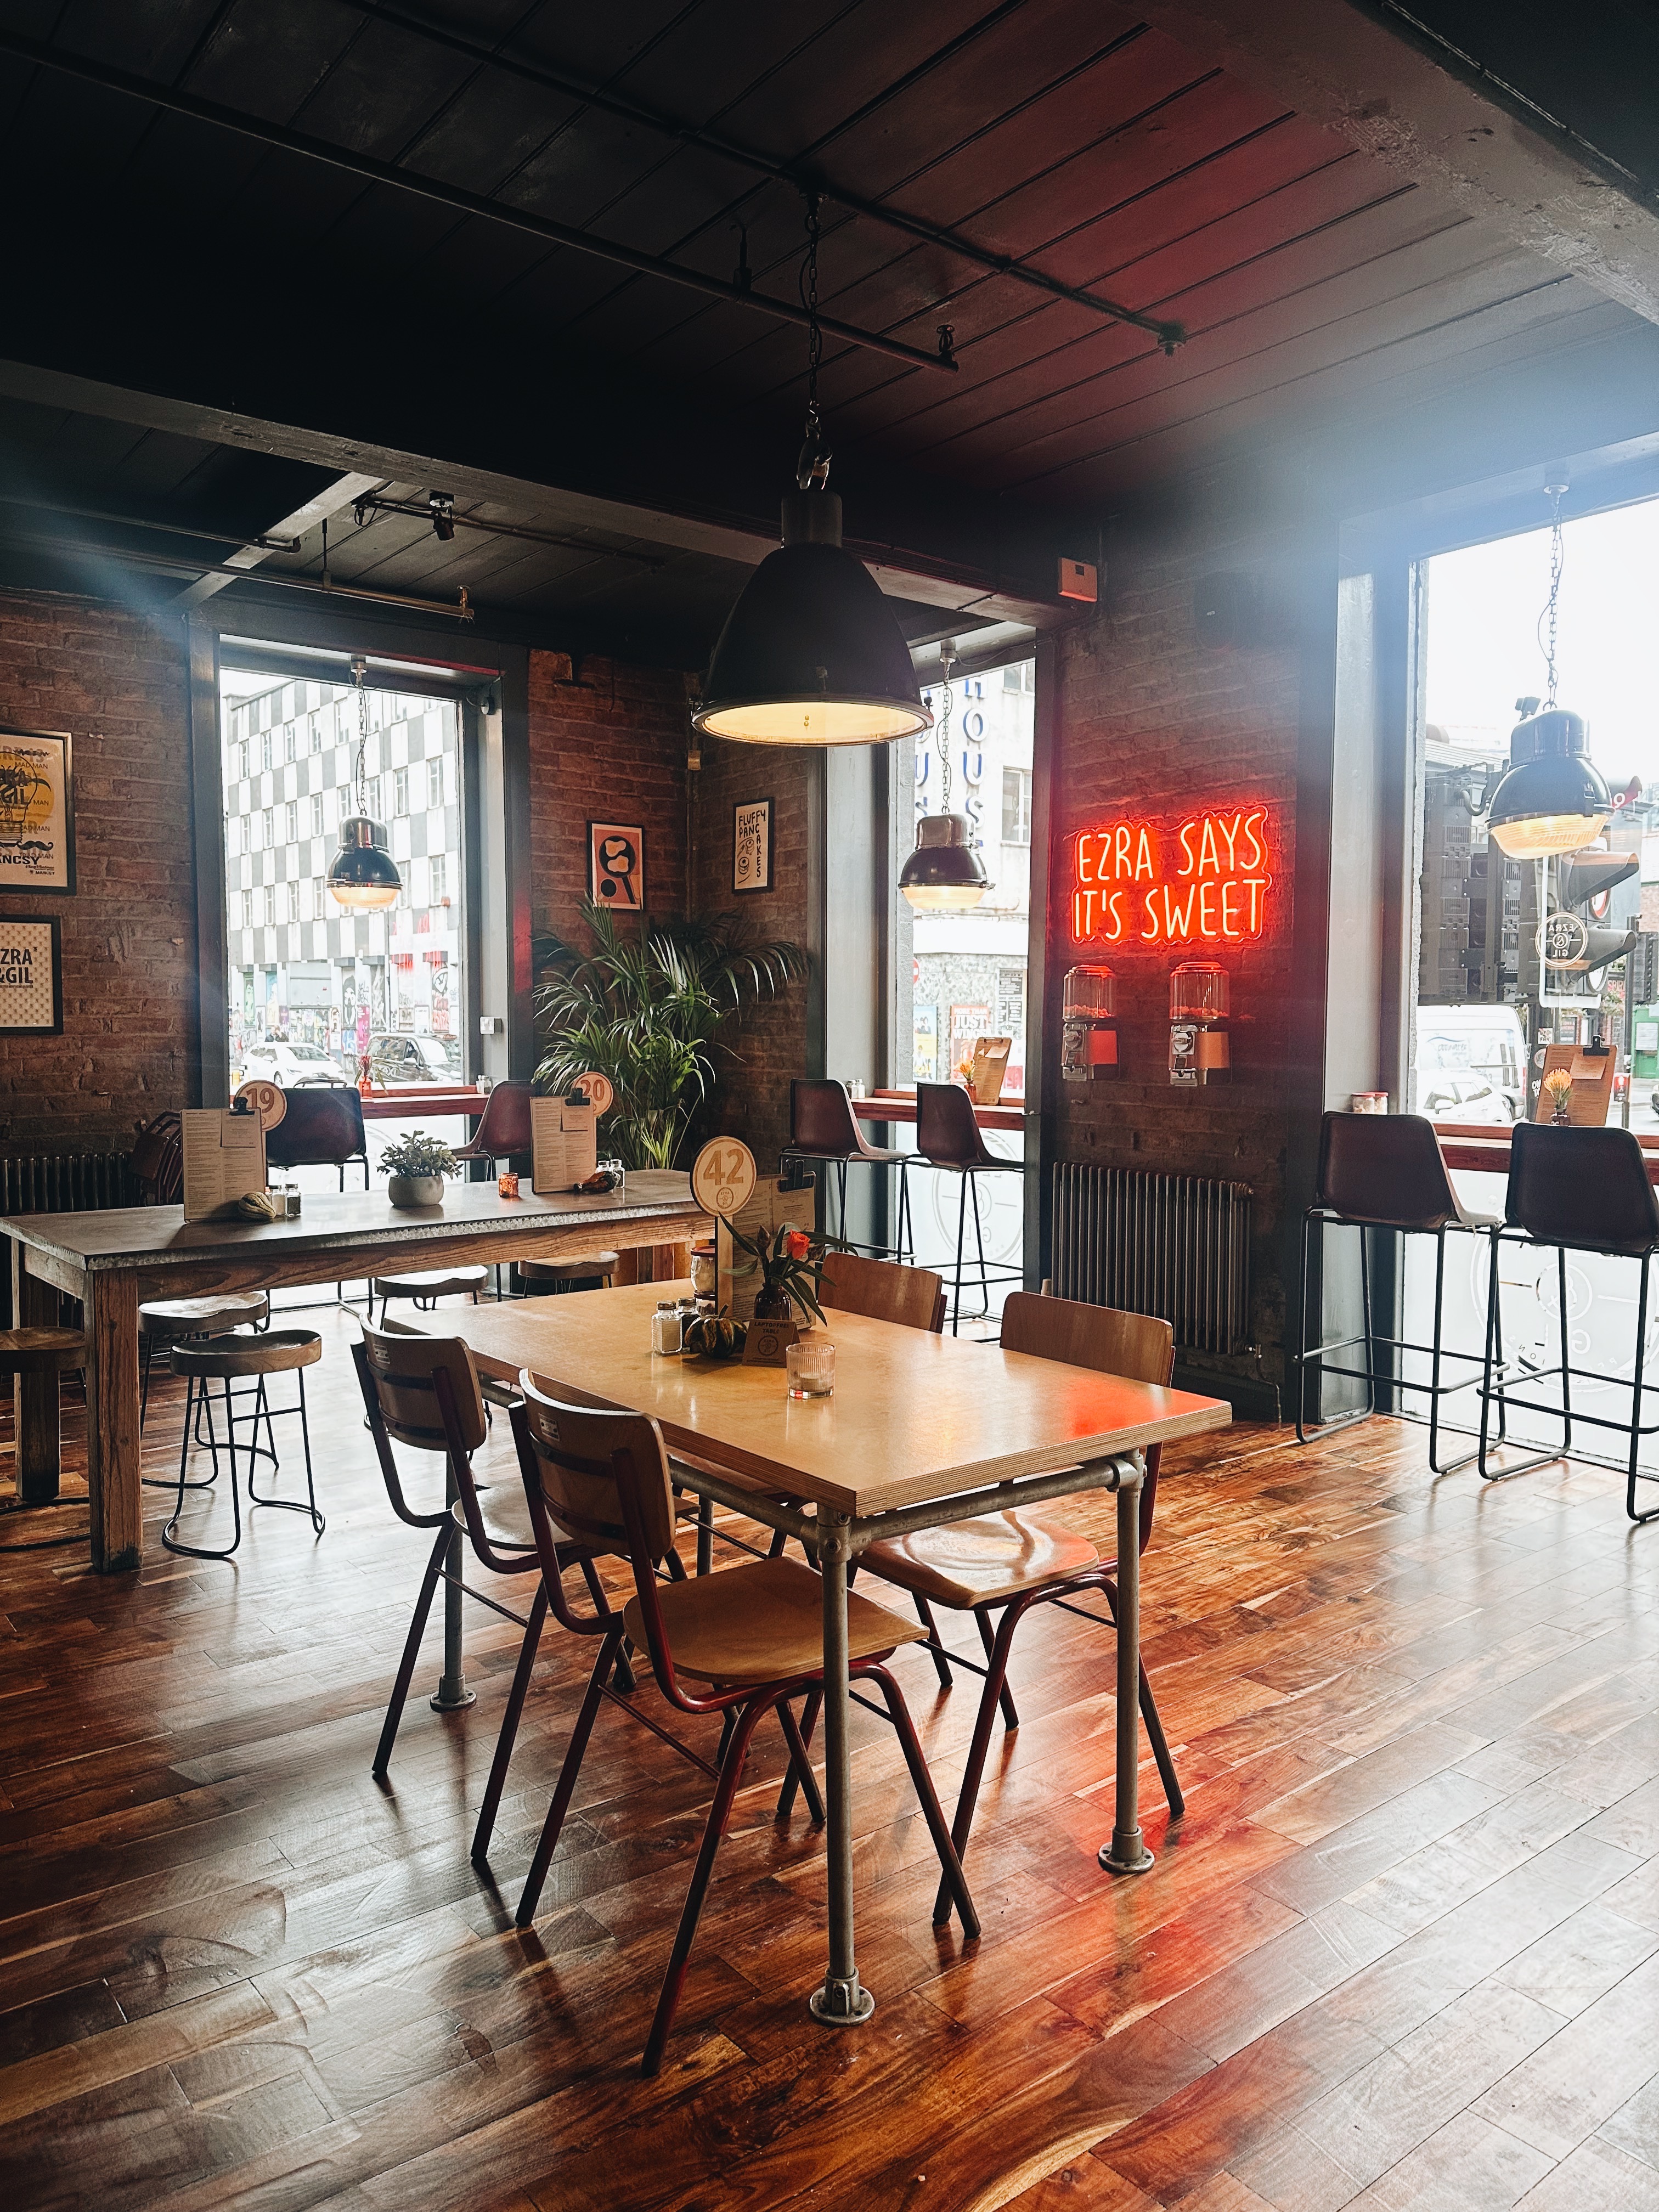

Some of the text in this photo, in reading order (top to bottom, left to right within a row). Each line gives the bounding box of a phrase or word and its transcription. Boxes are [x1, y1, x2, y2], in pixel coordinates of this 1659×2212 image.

[738, 809, 766, 827] FLUFFY
[1079, 812, 1262, 882] EZRA SAYS
[0, 855, 40, 865] NCSY
[1074, 879, 1266, 939] IT'S SWEET
[0, 949, 33, 965] ZRA
[955, 1015, 987, 1029] JUST
[246, 1088, 275, 1114] 19
[580, 1079, 605, 1101] 20
[703, 1148, 744, 1186] 42
